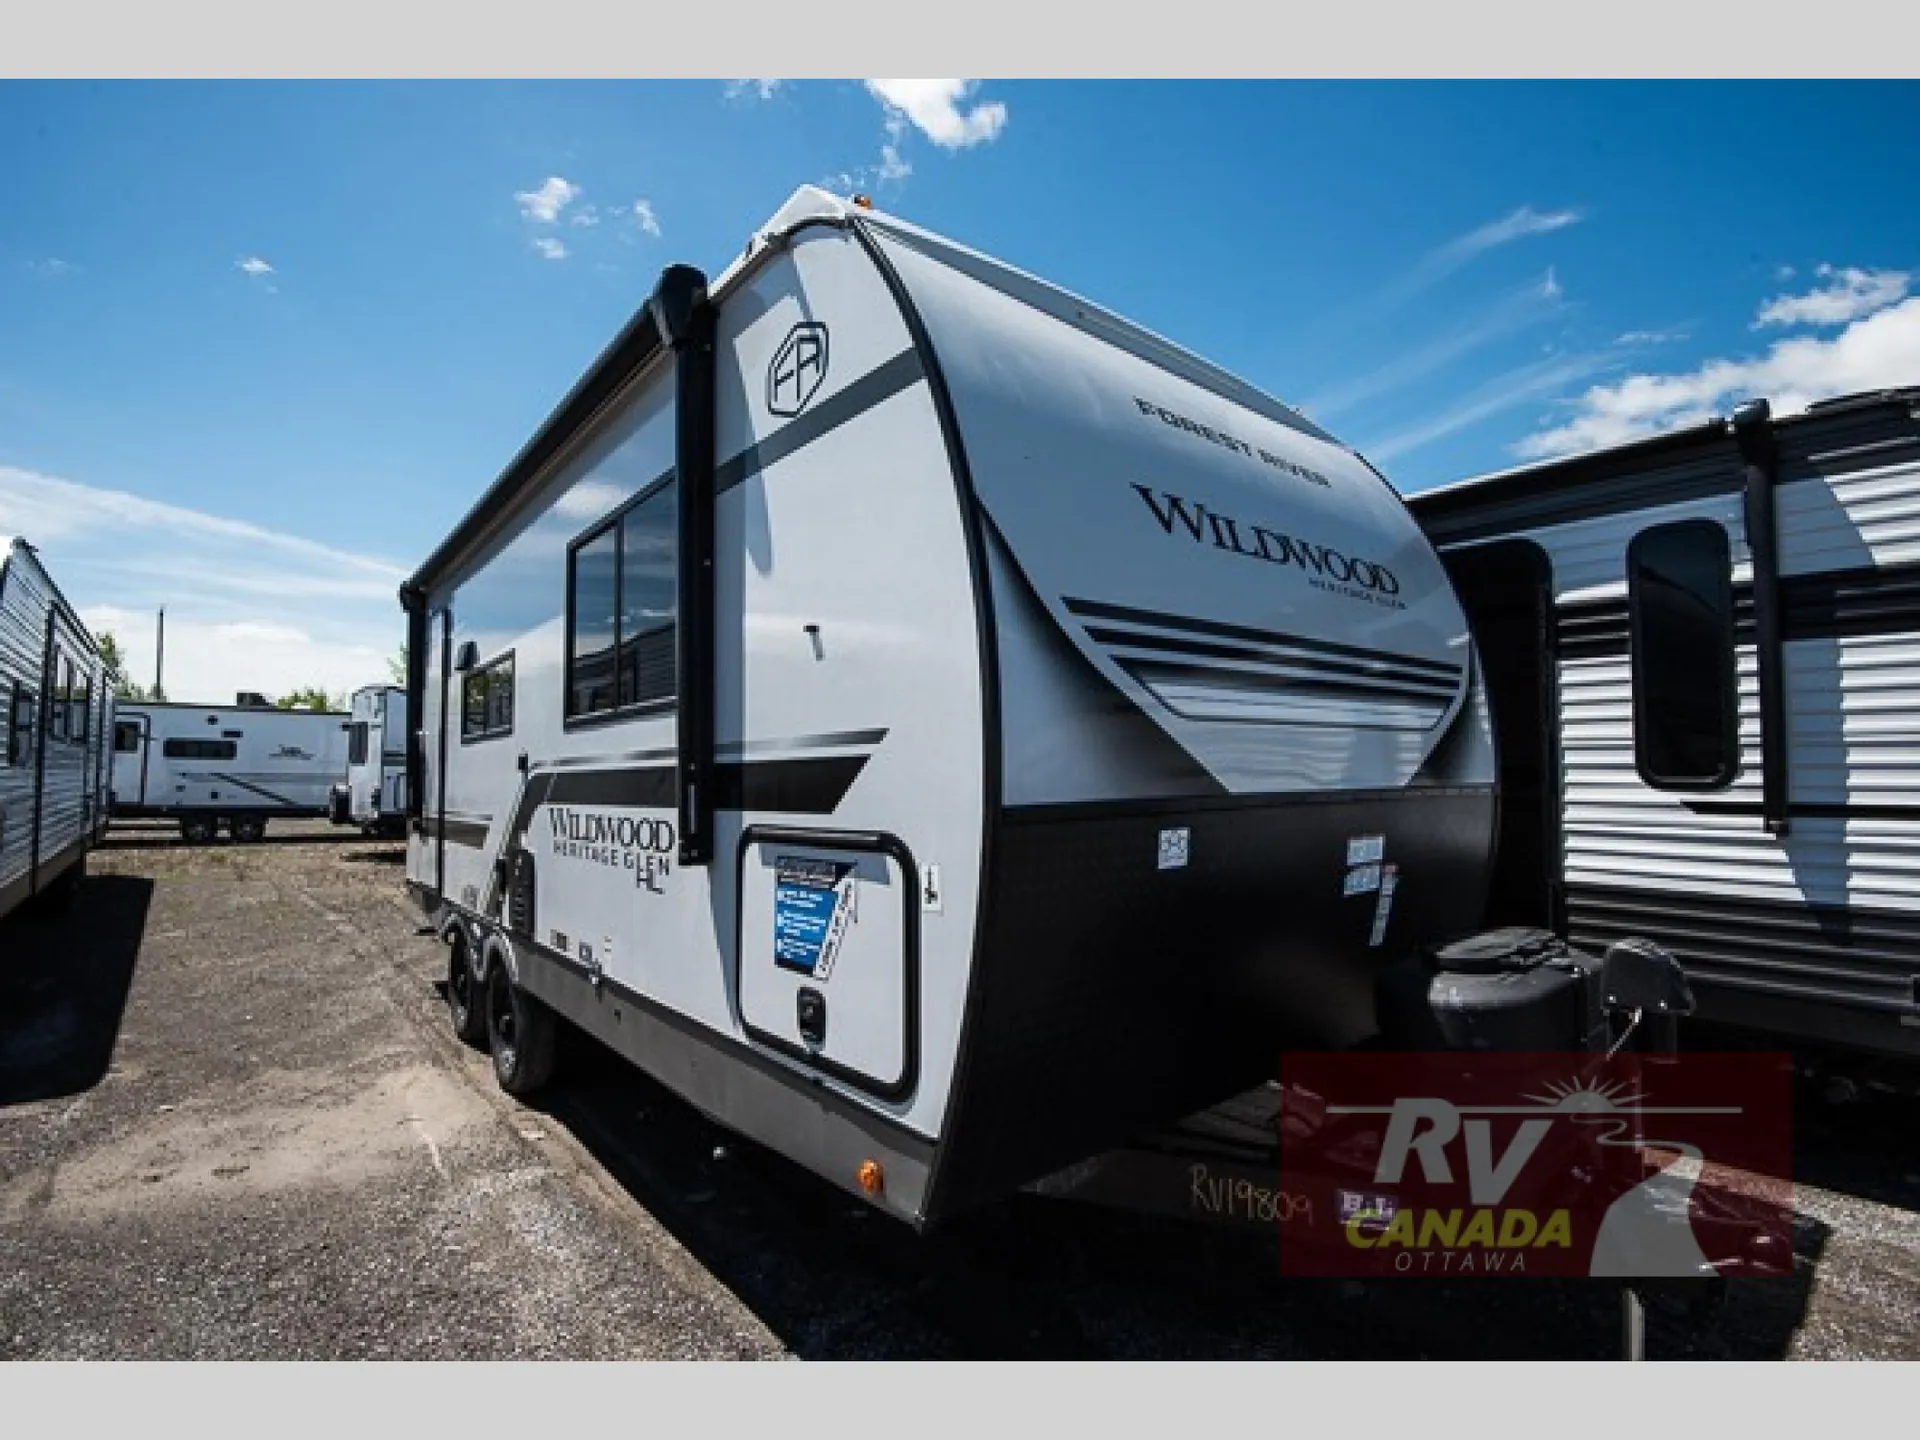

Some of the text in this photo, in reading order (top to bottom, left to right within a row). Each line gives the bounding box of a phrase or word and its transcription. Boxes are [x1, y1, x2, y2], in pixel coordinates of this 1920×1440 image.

[1130, 481, 1399, 594] WILDWOOD
[549, 807, 675, 853] WILDWOOD
[553, 840, 670, 876] HERITAGE GLEN
